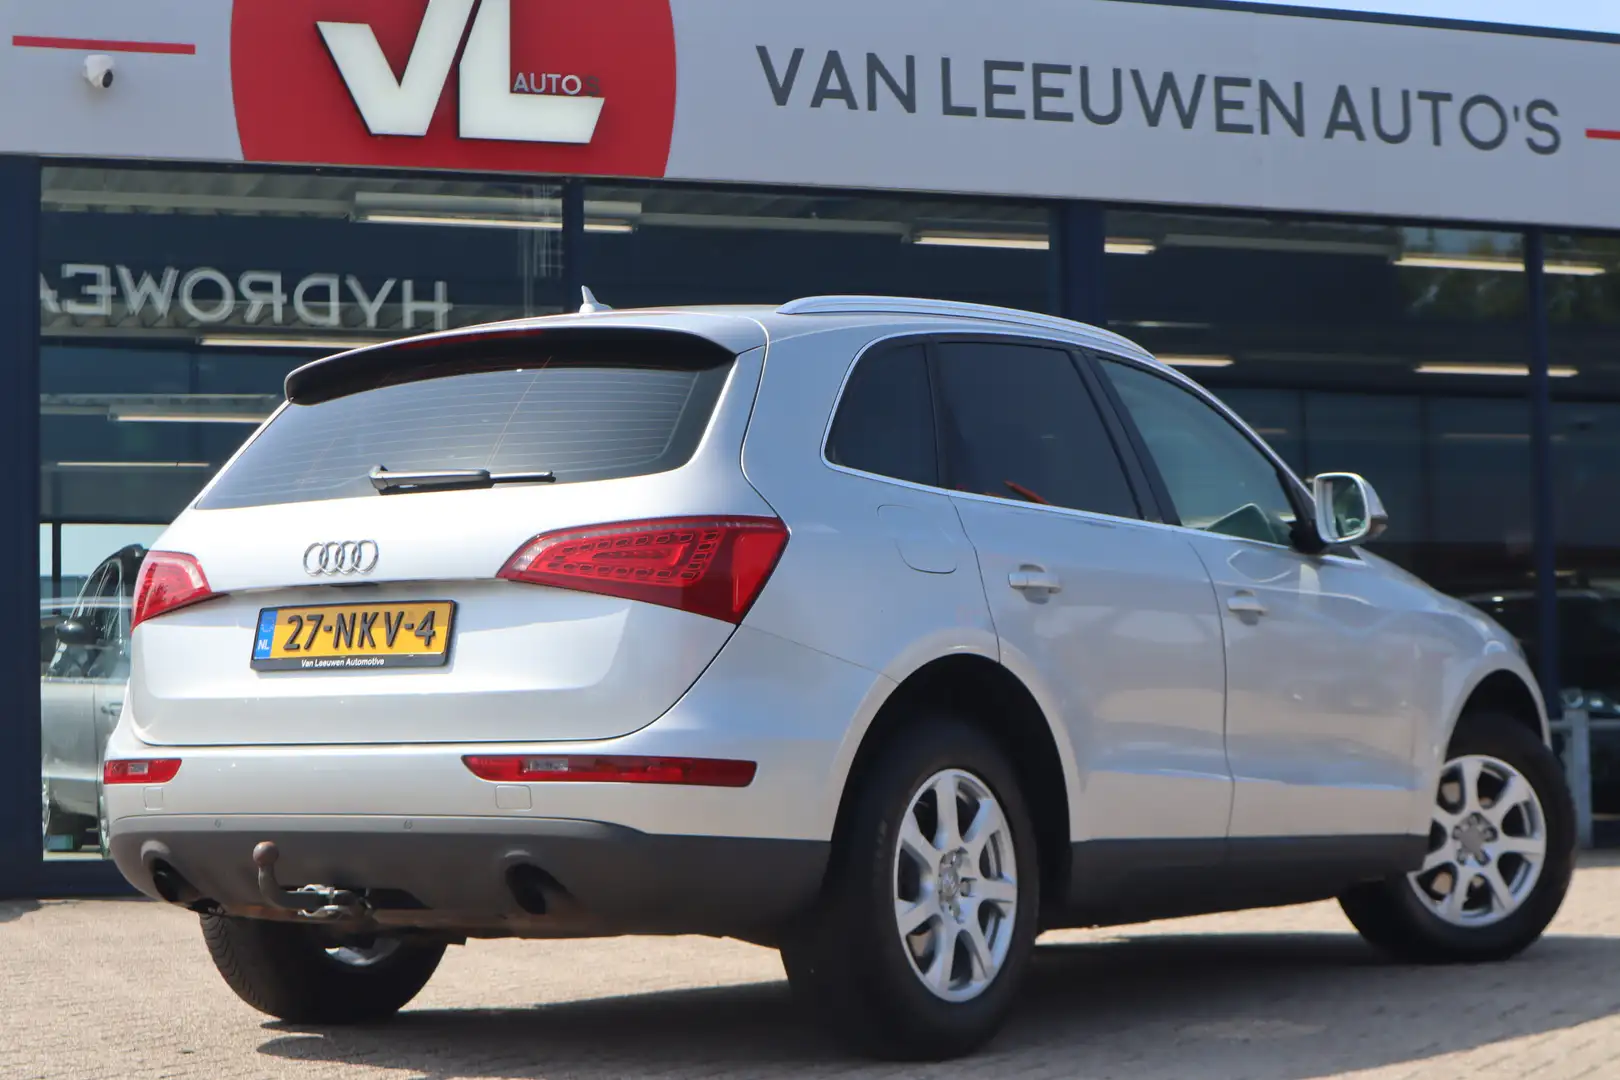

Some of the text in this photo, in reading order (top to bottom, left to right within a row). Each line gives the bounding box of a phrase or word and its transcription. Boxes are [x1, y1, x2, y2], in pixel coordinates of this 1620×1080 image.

[755, 45, 1562, 155] VAN LEEUWEN AUTO'S
[283, 610, 436, 651] 27-NKV-4
[257, 639, 270, 650] NL
[301, 656, 385, 668] Van Leeuwen Automotive
